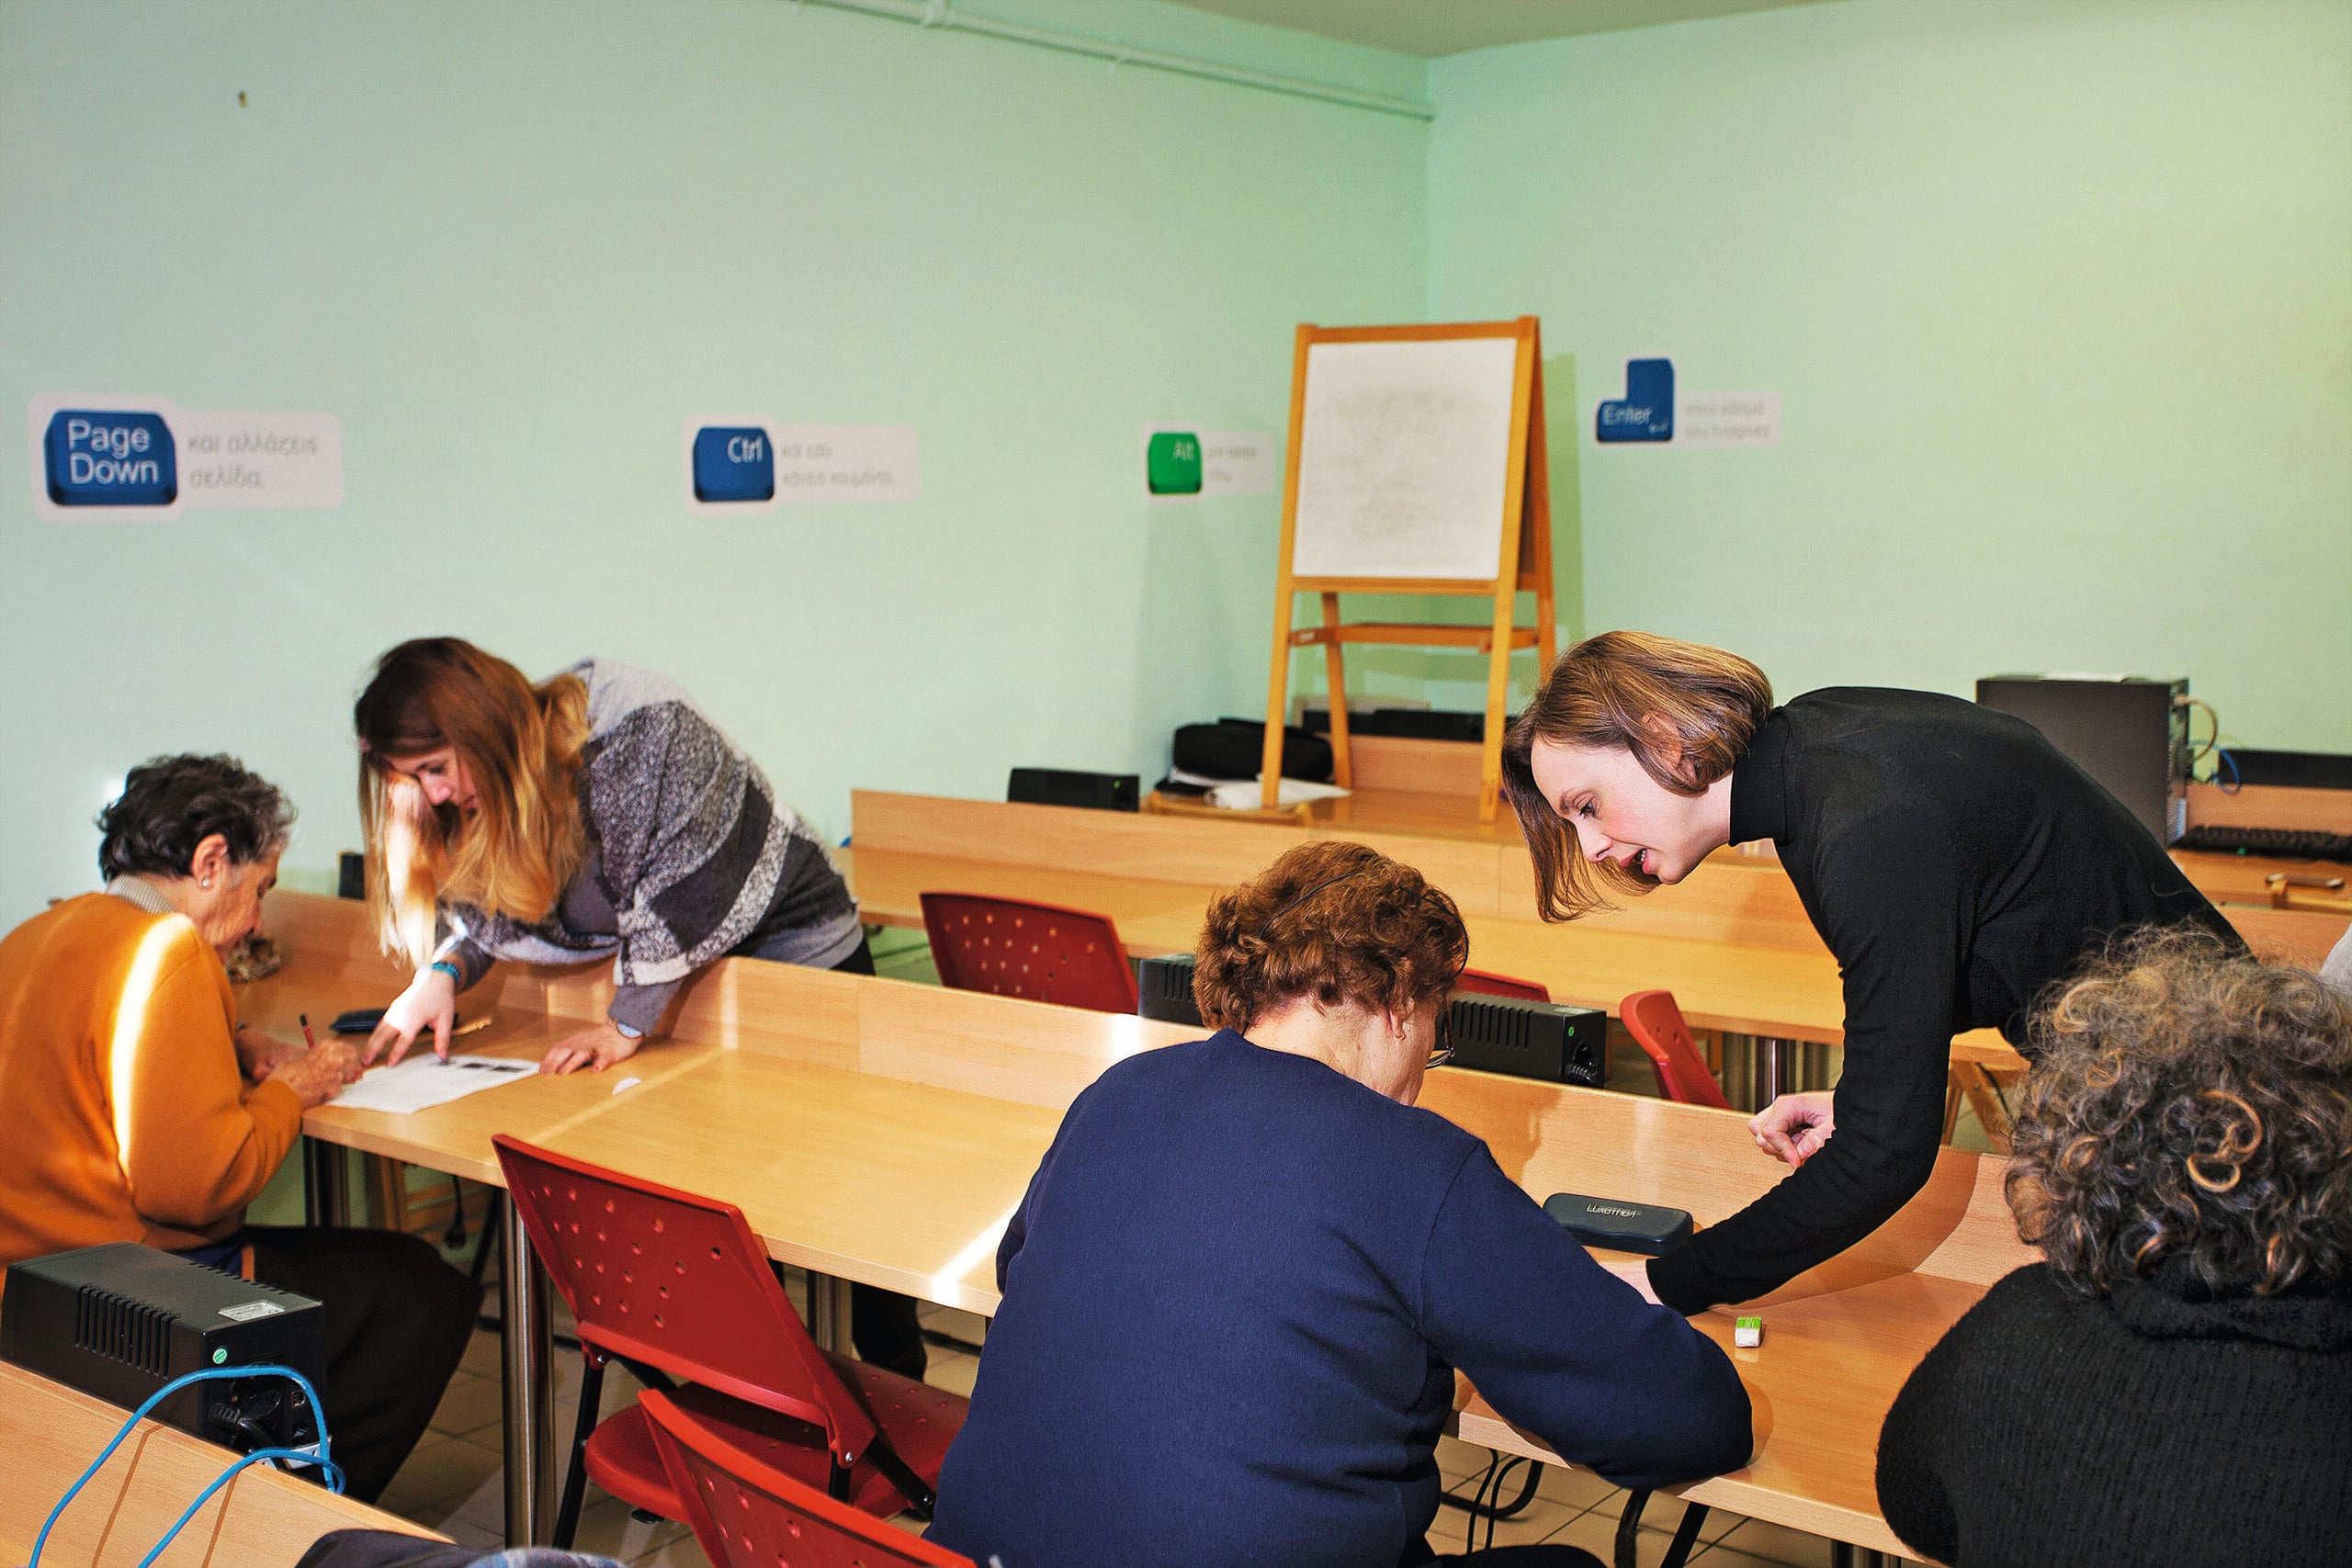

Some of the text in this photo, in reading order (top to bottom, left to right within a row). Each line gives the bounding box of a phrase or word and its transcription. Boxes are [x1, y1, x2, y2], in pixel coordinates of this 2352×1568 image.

[1602, 404, 1653, 426] Enter
[67, 419, 150, 457] Page
[727, 435, 763, 463] Ctrl
[70, 453, 159, 484] Down
